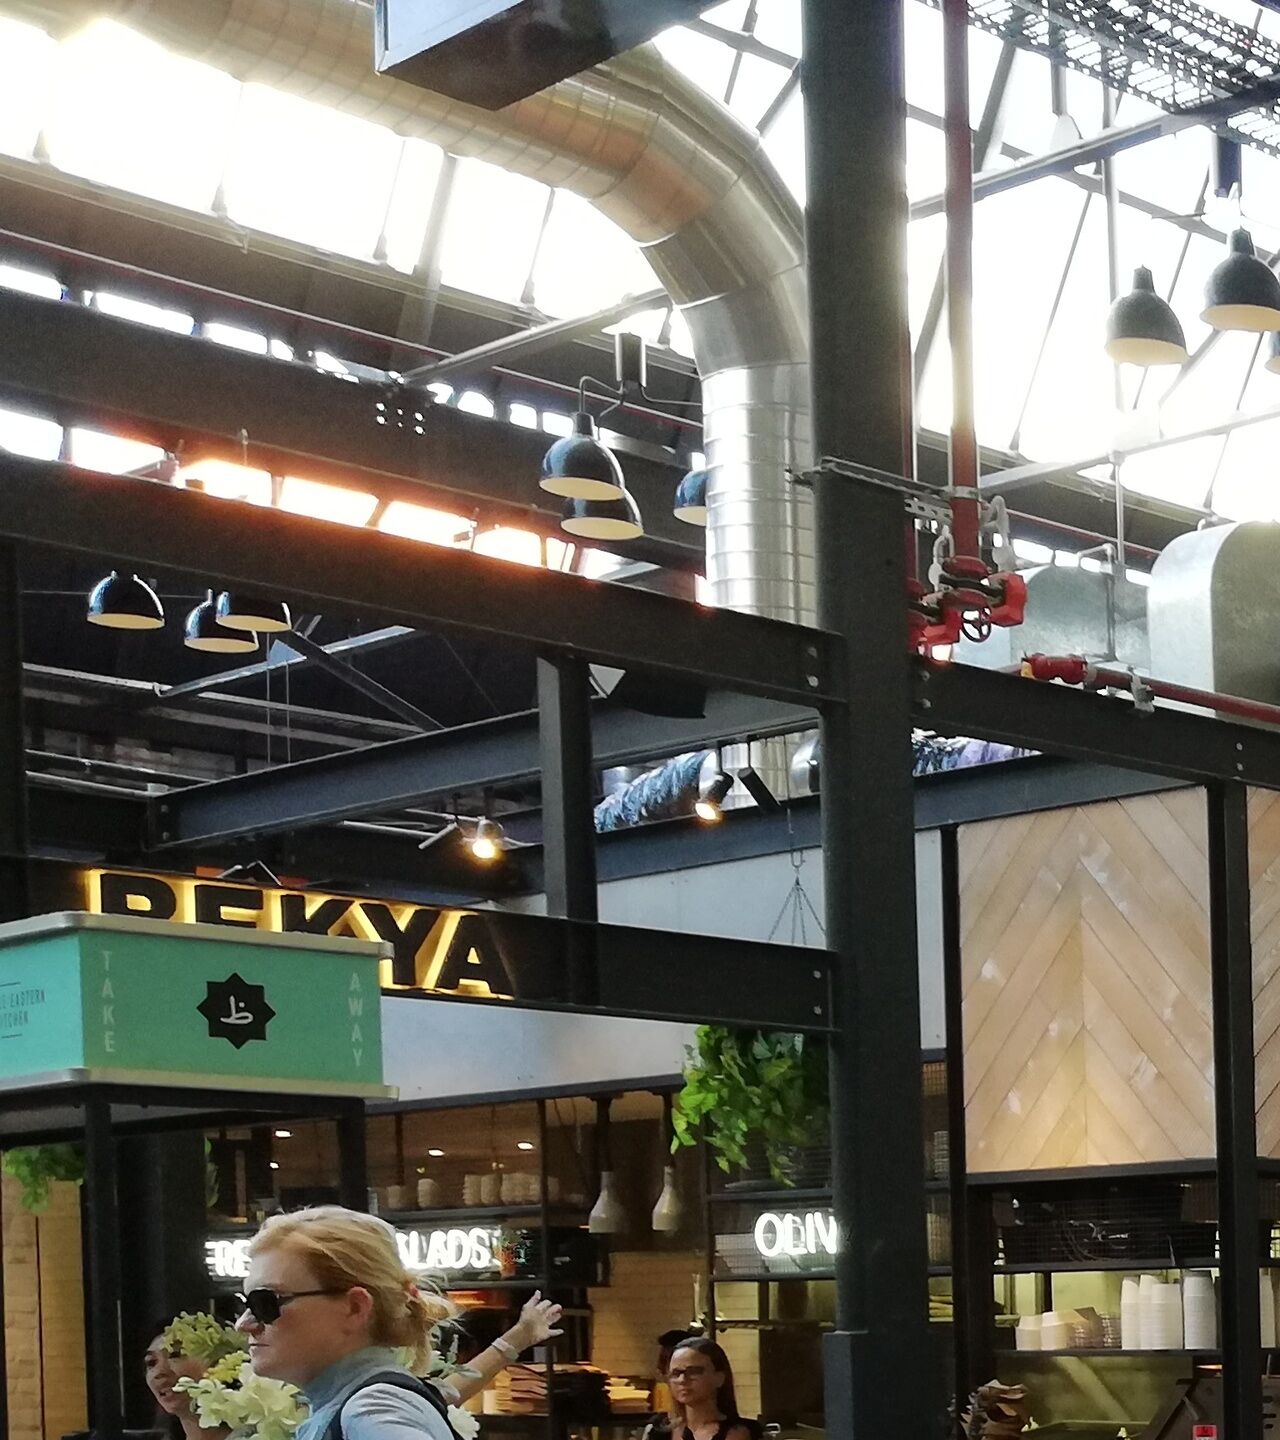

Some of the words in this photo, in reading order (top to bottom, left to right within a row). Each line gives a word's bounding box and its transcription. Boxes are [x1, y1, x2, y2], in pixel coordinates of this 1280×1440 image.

[102, 950, 116, 1053] TAKE
[348, 972, 364, 1068] AWAY
[396, 1227, 491, 1270] LADS
[754, 1211, 838, 1257] OLIV
